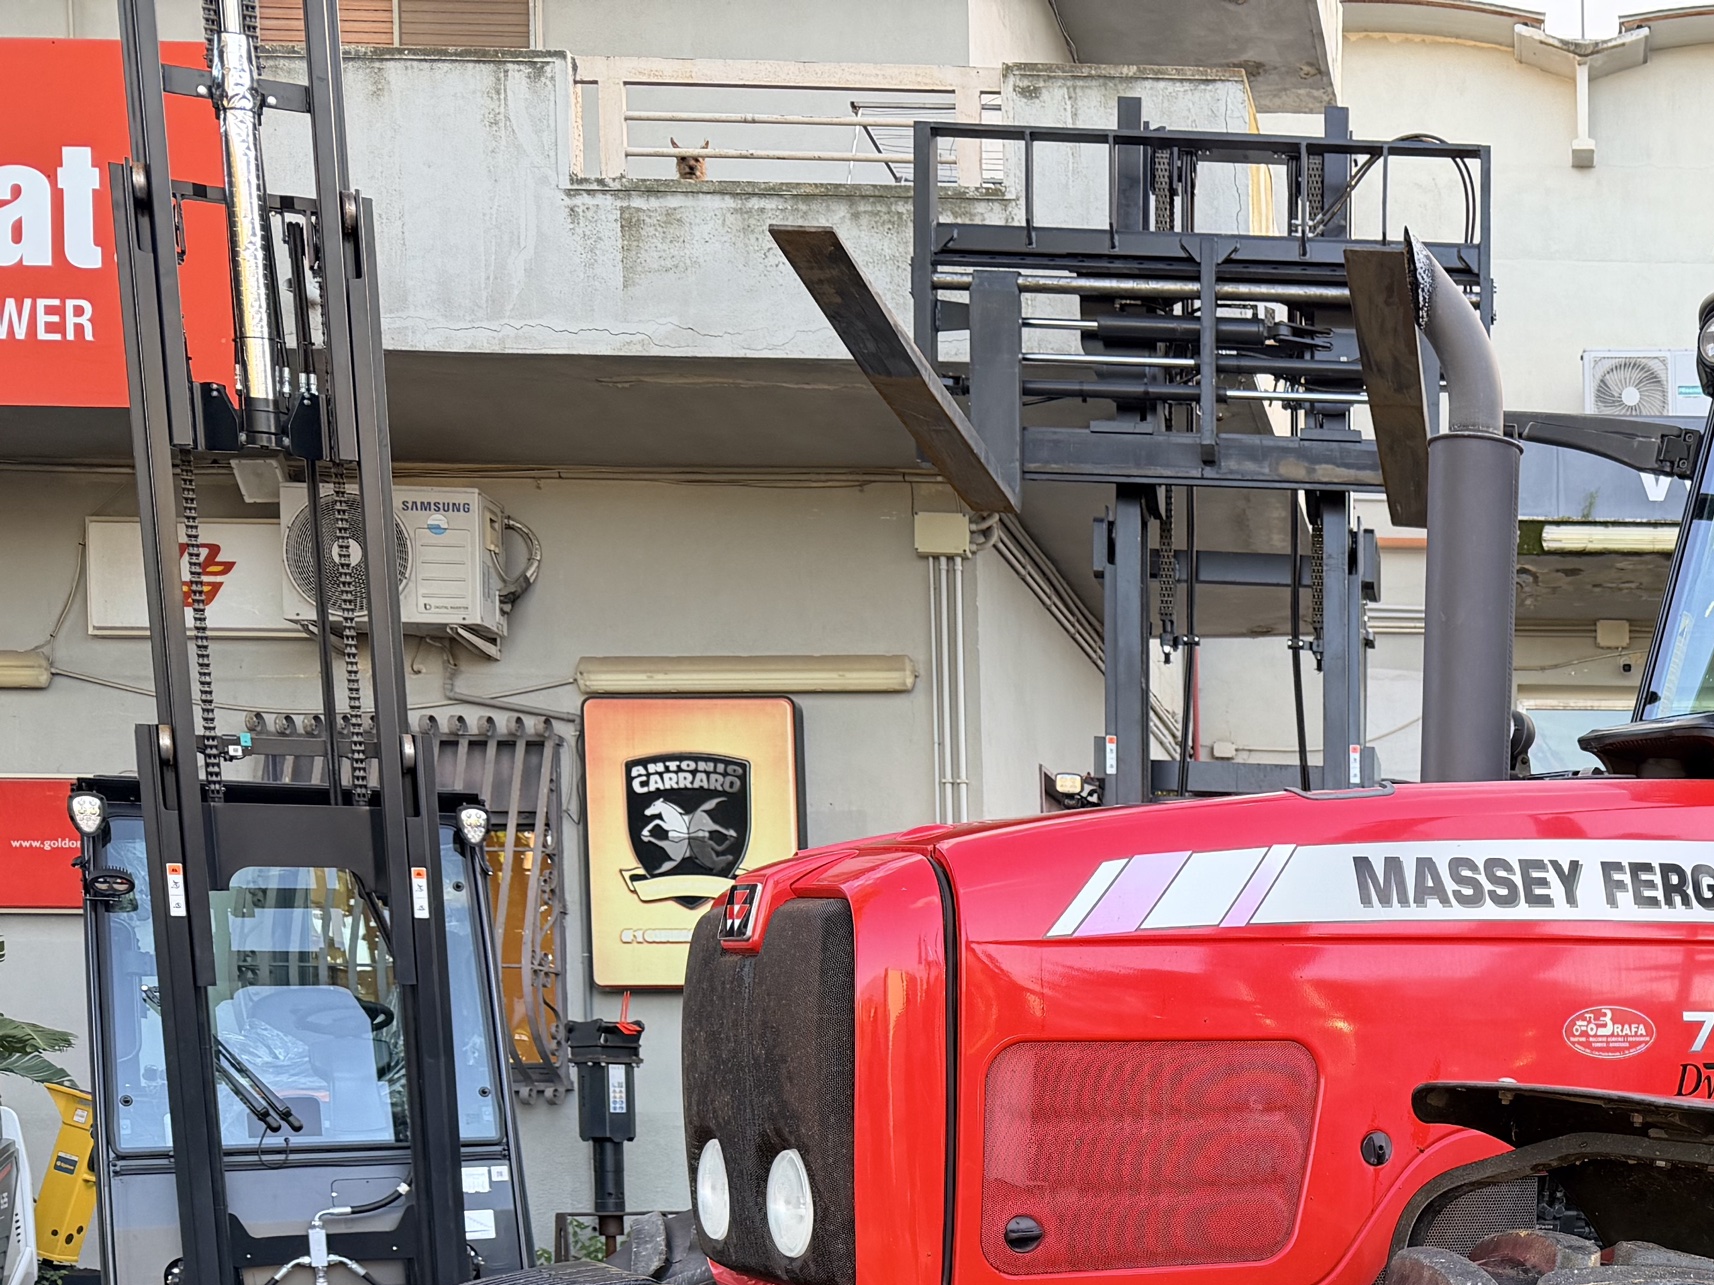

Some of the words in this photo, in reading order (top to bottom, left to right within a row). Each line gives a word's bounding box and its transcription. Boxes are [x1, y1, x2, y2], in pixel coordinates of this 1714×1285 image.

[401, 500, 471, 513] SAMSUNG
[630, 759, 743, 778] ANTONIO
[631, 771, 741, 794] CARRARO
[1352, 855, 1583, 909] MASSEY
